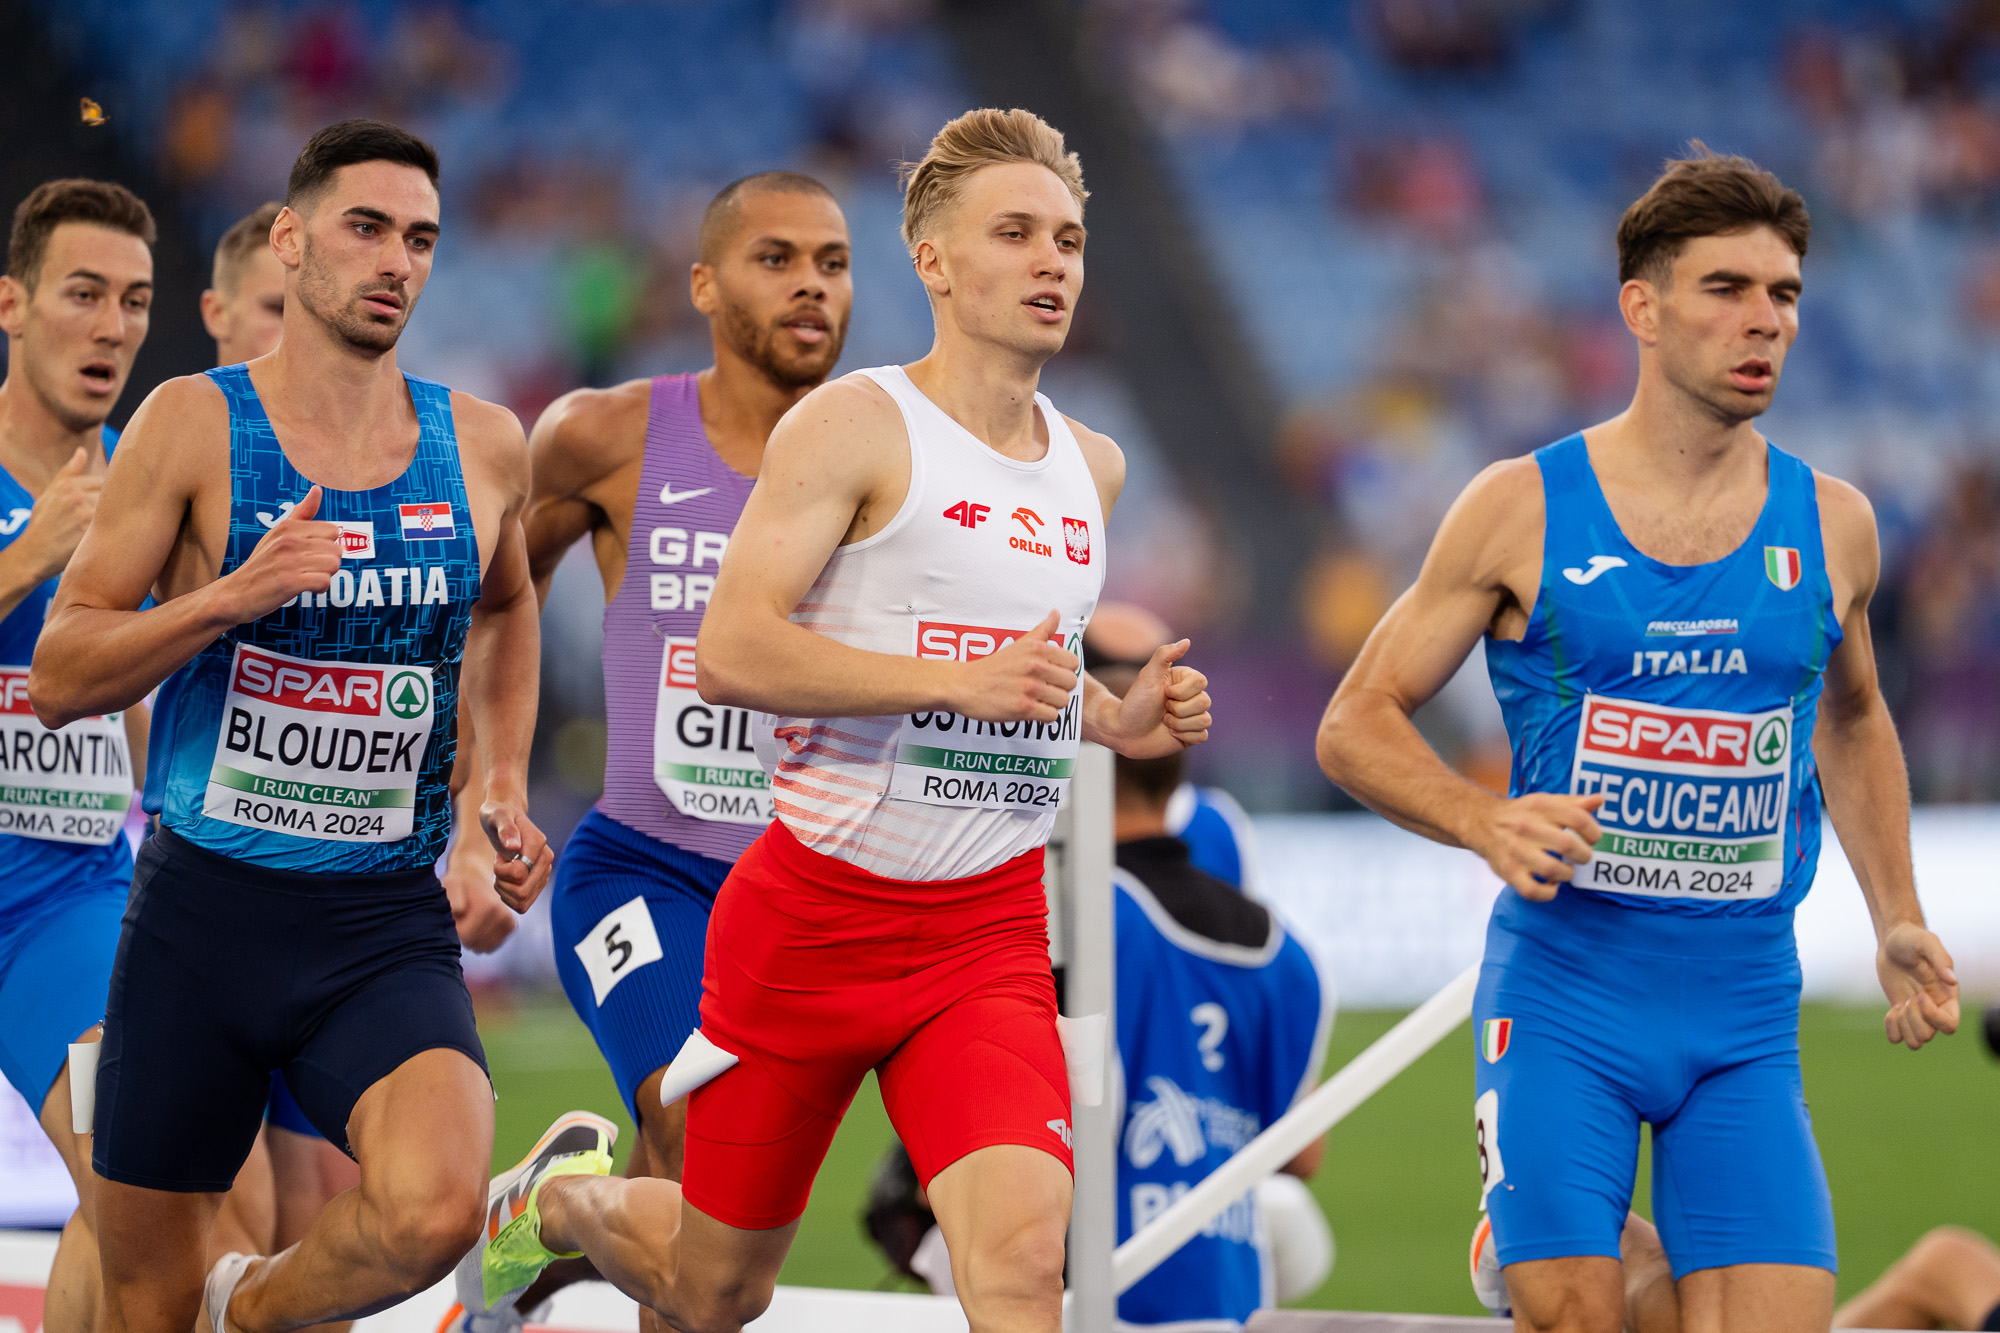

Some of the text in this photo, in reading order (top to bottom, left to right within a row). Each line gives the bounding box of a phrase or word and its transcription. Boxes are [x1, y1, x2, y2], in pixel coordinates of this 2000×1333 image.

[943, 500, 991, 529] 4F
[1009, 537, 1052, 557] ORLEN
[282, 566, 449, 608] OATIA
[1632, 648, 1748, 676] ITALIA
[239, 657, 379, 709] SPAR
[225, 706, 422, 773] BLOUDEK
[676, 705, 754, 753] GIL
[1589, 709, 1747, 761] SPAR
[705, 767, 747, 786] RUN
[953, 753, 992, 770] RUN
[4, 787, 42, 805] RUN
[263, 779, 306, 799] RUN
[683, 789, 760, 817] ROMA
[923, 775, 1060, 807] ROMA 2024
[1578, 769, 1783, 833] TECUCEANU
[63, 815, 114, 838] 2024
[234, 798, 385, 836] ROMA 2024
[1623, 838, 1668, 857] RUN
[1594, 861, 1753, 893] ROMA 2024
[605, 922, 632, 973] 5
